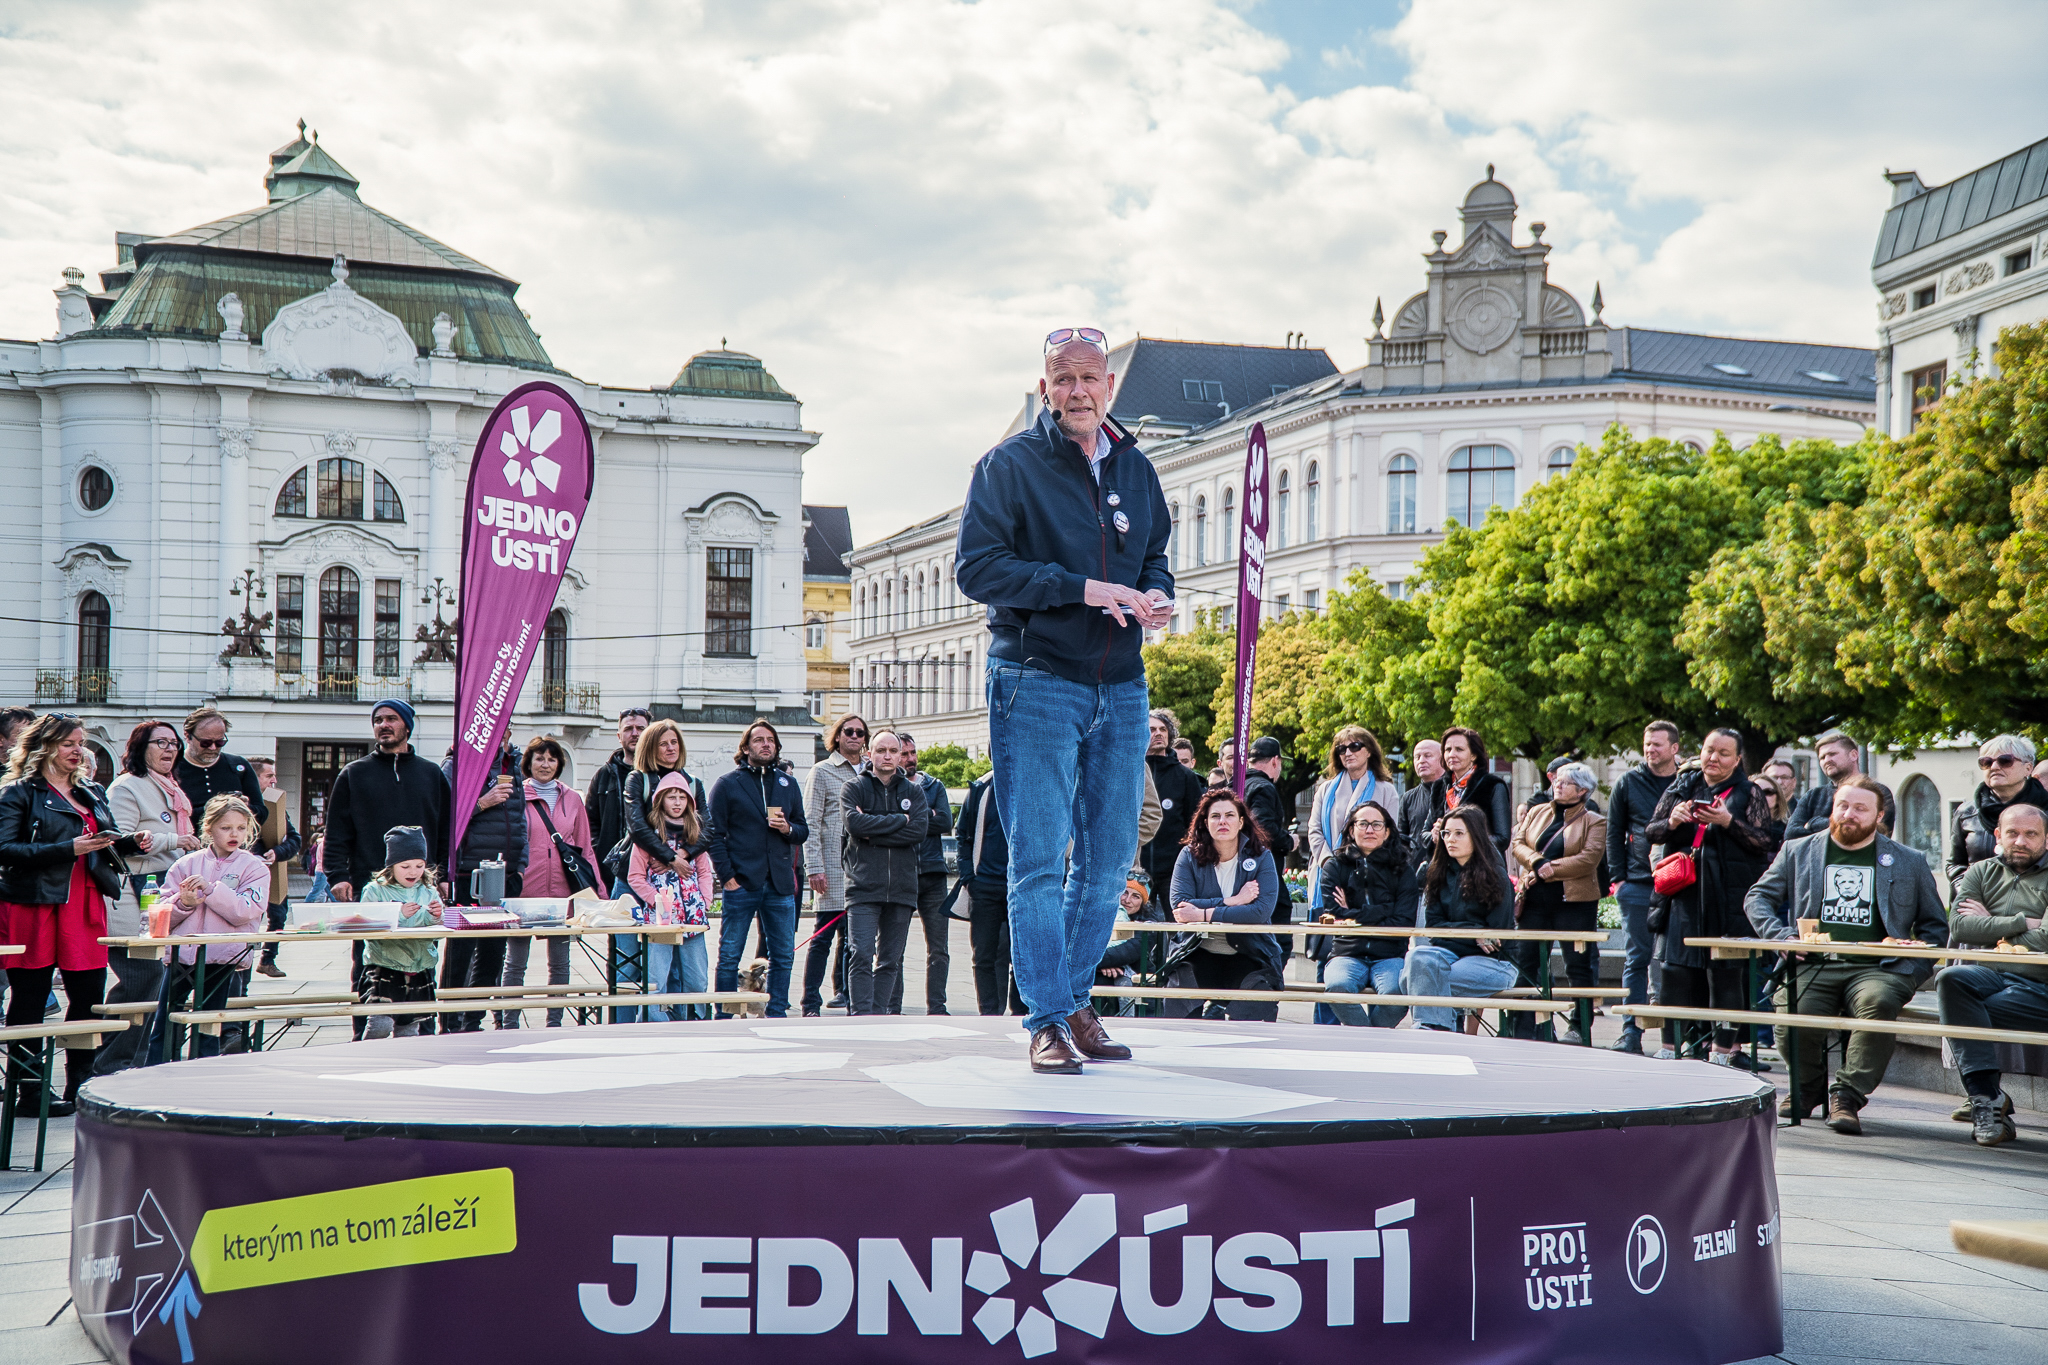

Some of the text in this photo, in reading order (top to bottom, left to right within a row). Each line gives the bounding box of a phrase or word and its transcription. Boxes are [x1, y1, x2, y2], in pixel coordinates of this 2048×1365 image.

[477, 495, 576, 541] JEDNO
[491, 529, 559, 575] ÚSTÍ
[1244, 524, 1265, 568] JEDNO
[463, 641, 512, 746] Spojili jsme ty,
[473, 712, 496, 754] kteří
[488, 675, 512, 716] tomu
[506, 619, 533, 678] rozumí.
[1823, 905, 1870, 919] DUMP
[1823, 915, 1869, 925] TRUMP
[223, 1196, 480, 1262] kterým na tom záleží
[1523, 1229, 1588, 1267] PRO!
[1693, 1219, 1737, 1262] ZELENÍ
[1119, 1198, 1415, 1335] ÚSTÍ
[1525, 1264, 1593, 1311] ÚSTÍ
